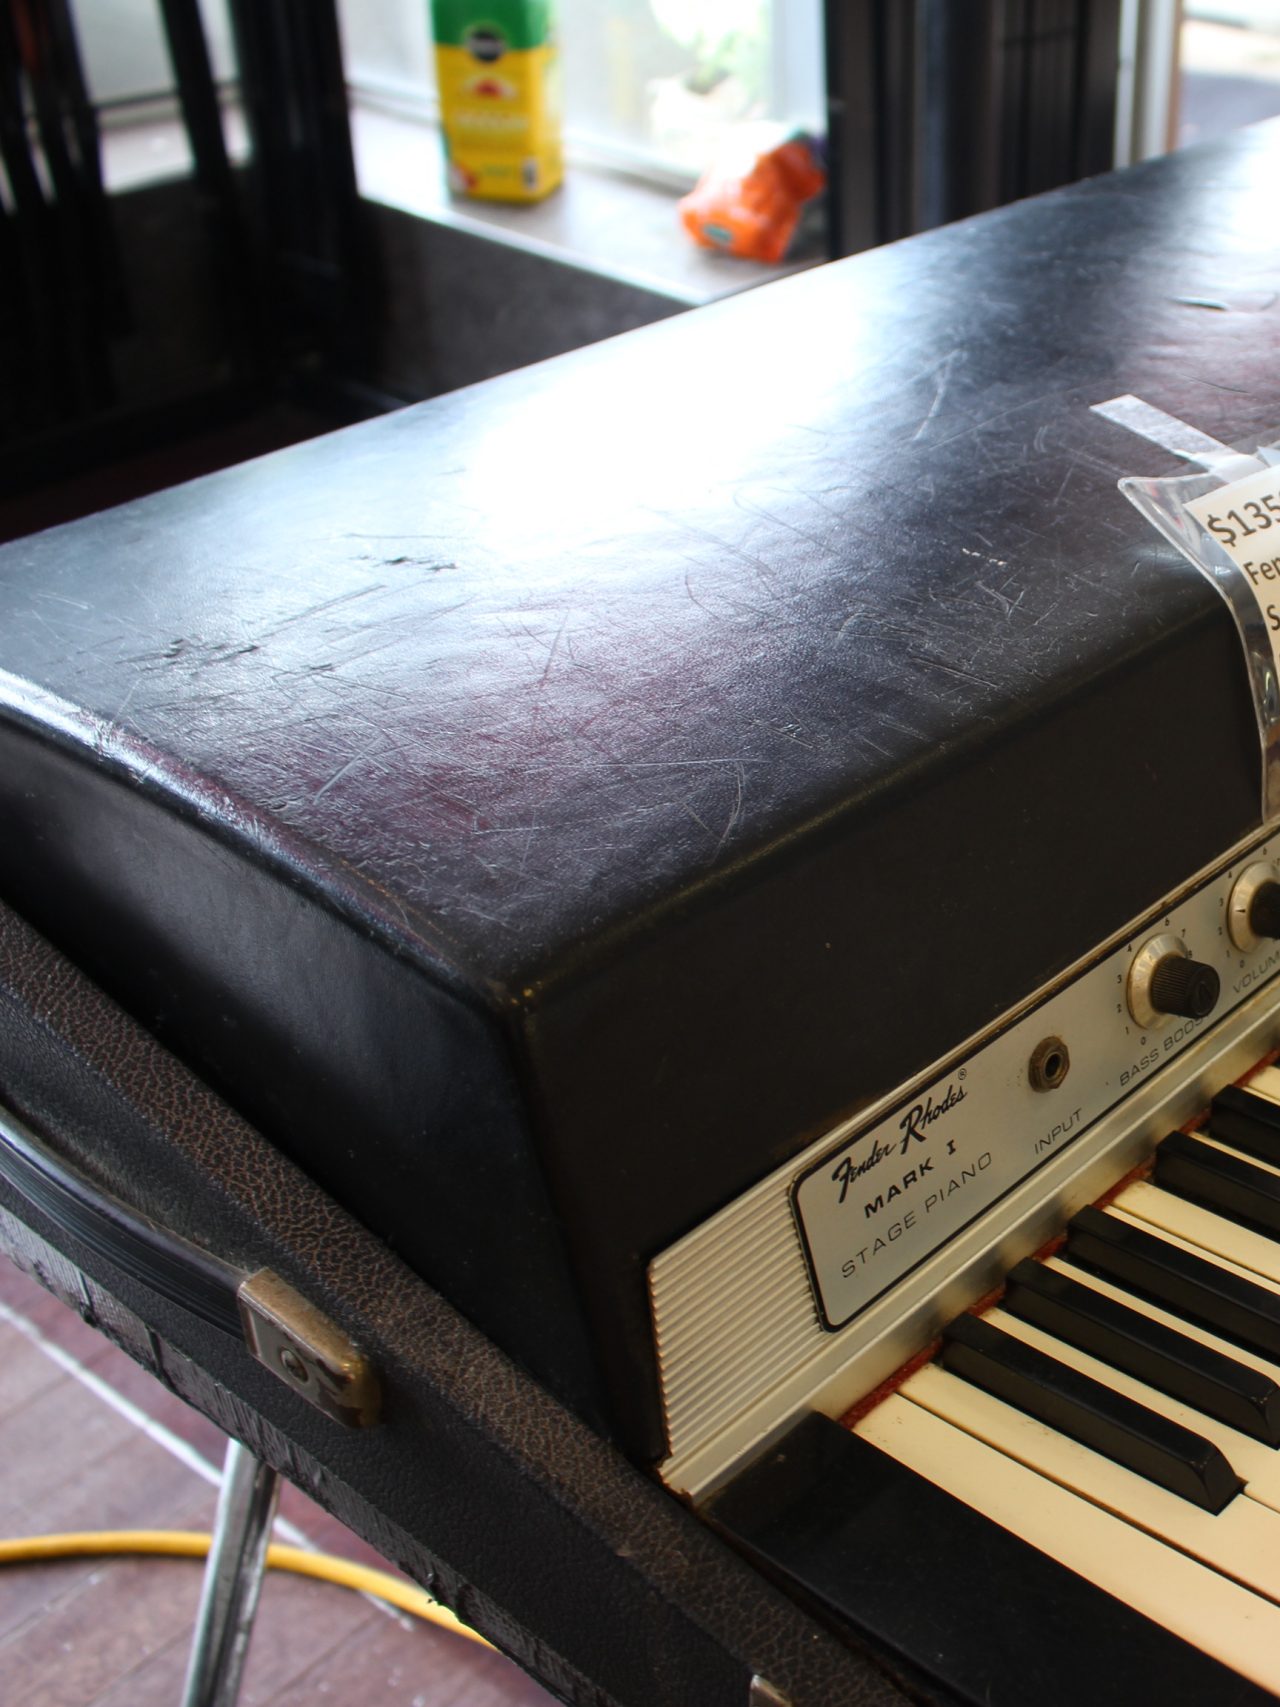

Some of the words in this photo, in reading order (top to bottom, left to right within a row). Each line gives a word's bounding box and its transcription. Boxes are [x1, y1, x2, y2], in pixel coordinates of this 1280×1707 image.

[1119, 1048, 1160, 1086] BASS
[1163, 1014, 1206, 1051] BOOS
[831, 1139, 896, 1204] Fender
[899, 1084, 968, 1155] Rhodes
[1034, 1107, 1083, 1155] INPUT
[841, 1210, 917, 1279] STAGE
[924, 1151, 993, 1213] PIANO
[863, 1157, 934, 1218] MARK
